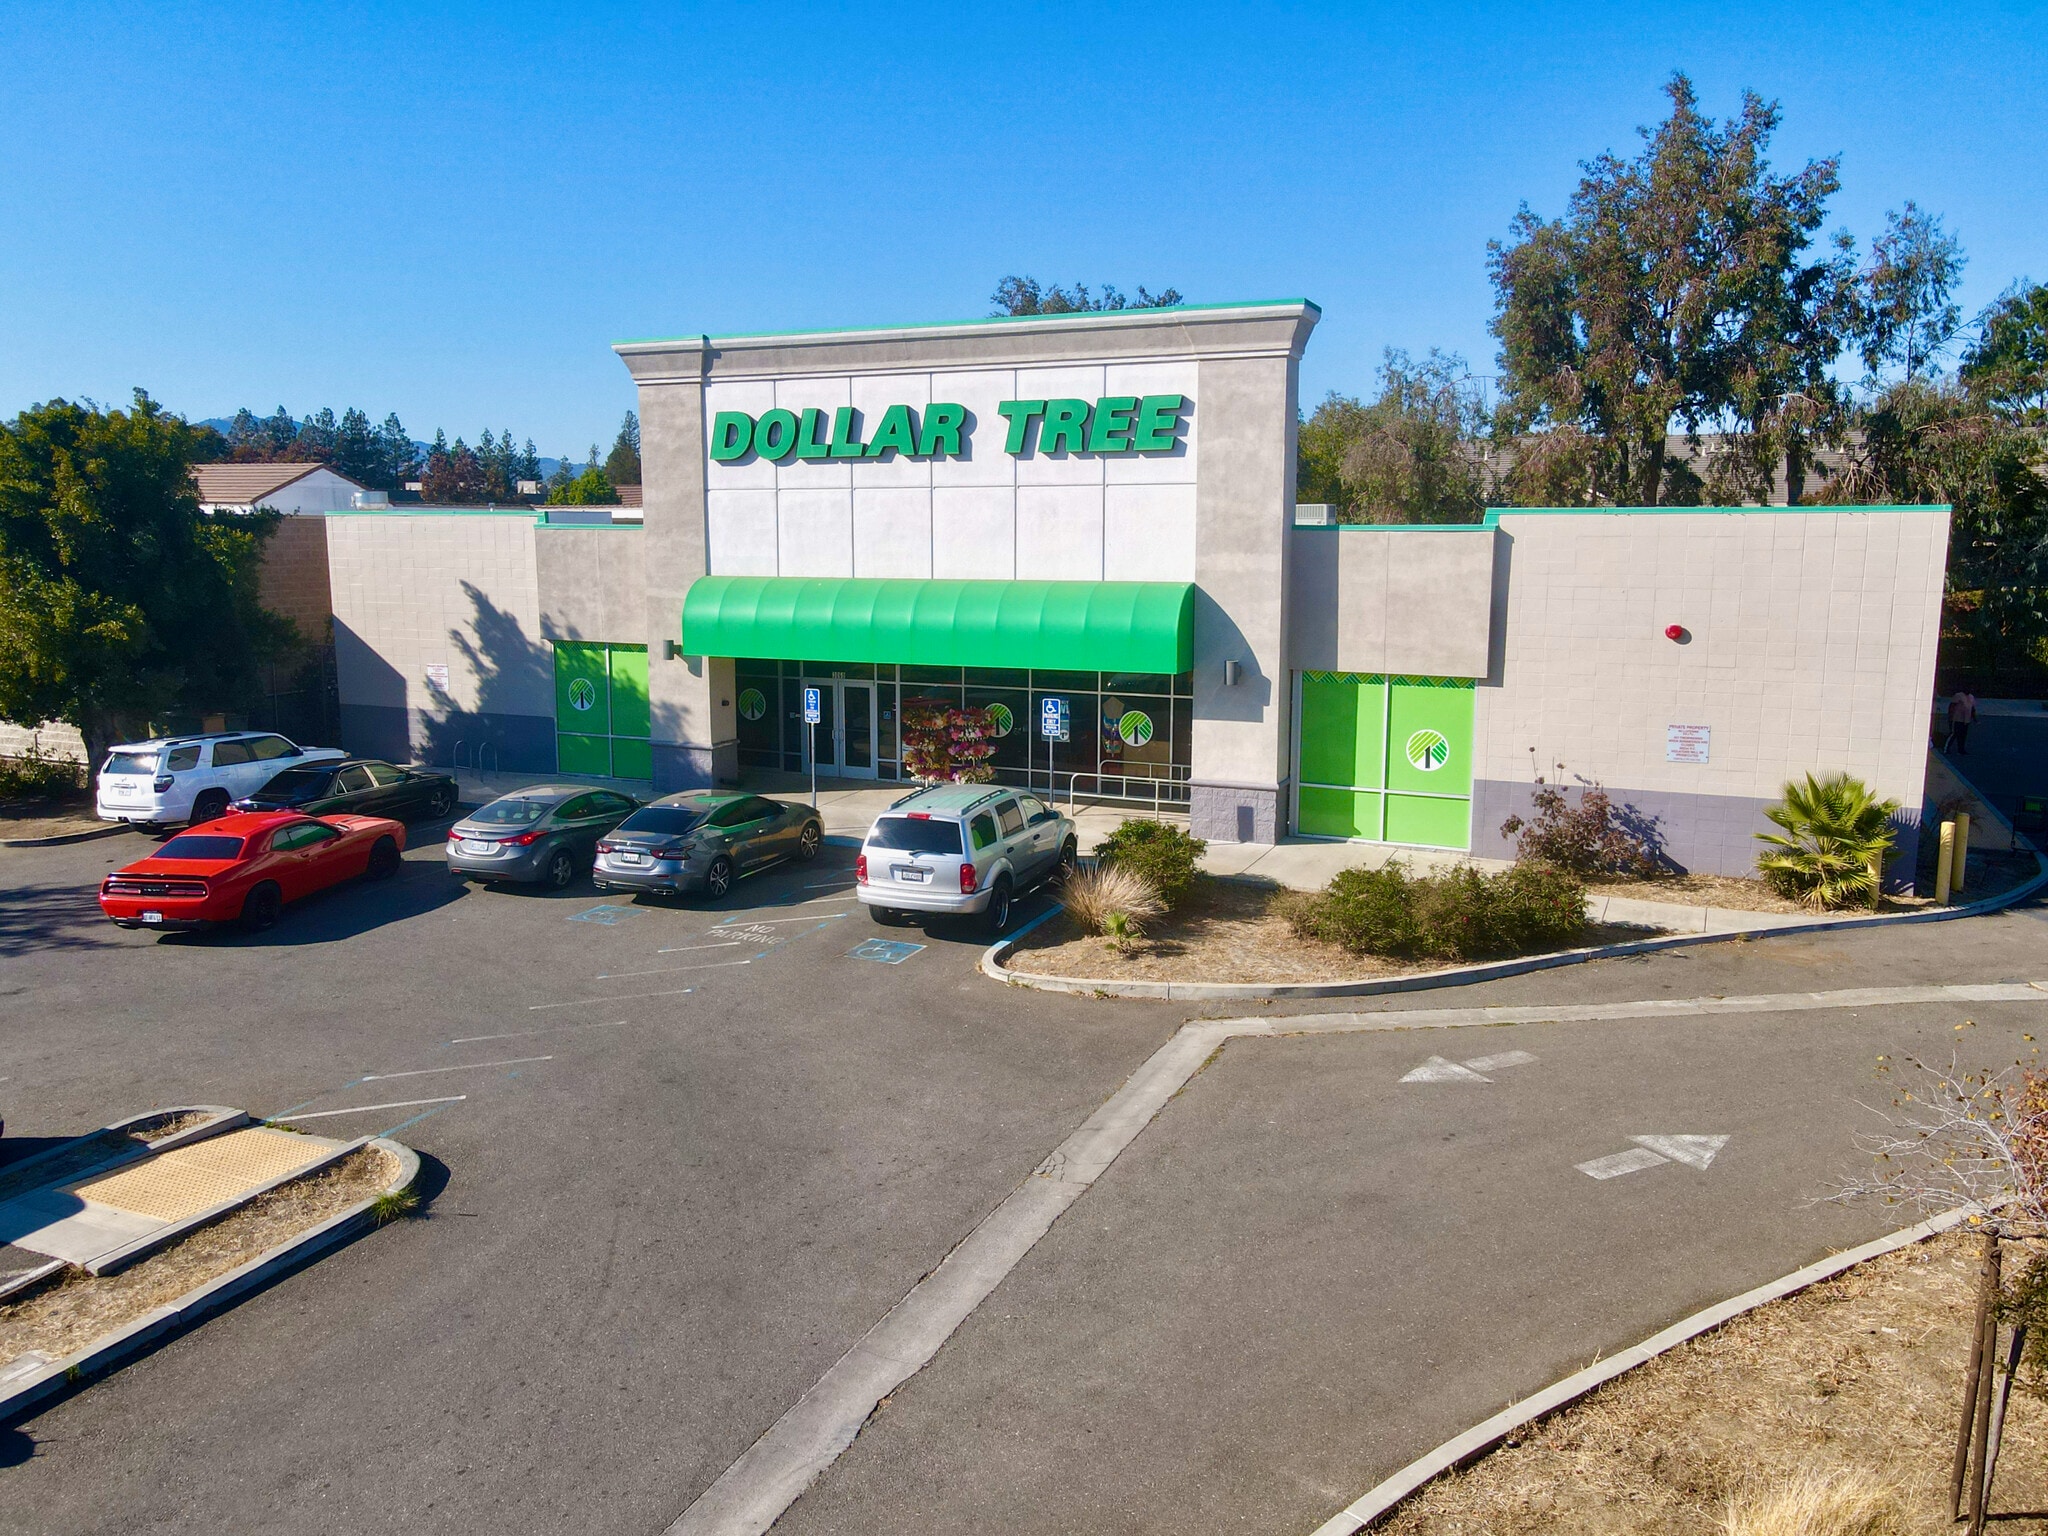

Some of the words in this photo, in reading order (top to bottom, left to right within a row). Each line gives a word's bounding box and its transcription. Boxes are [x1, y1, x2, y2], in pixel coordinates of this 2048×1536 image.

[709, 402, 968, 462] DOLLAR
[998, 394, 1185, 454] TREE
[704, 929, 784, 945] PARKING
[744, 924, 776, 934] NO
